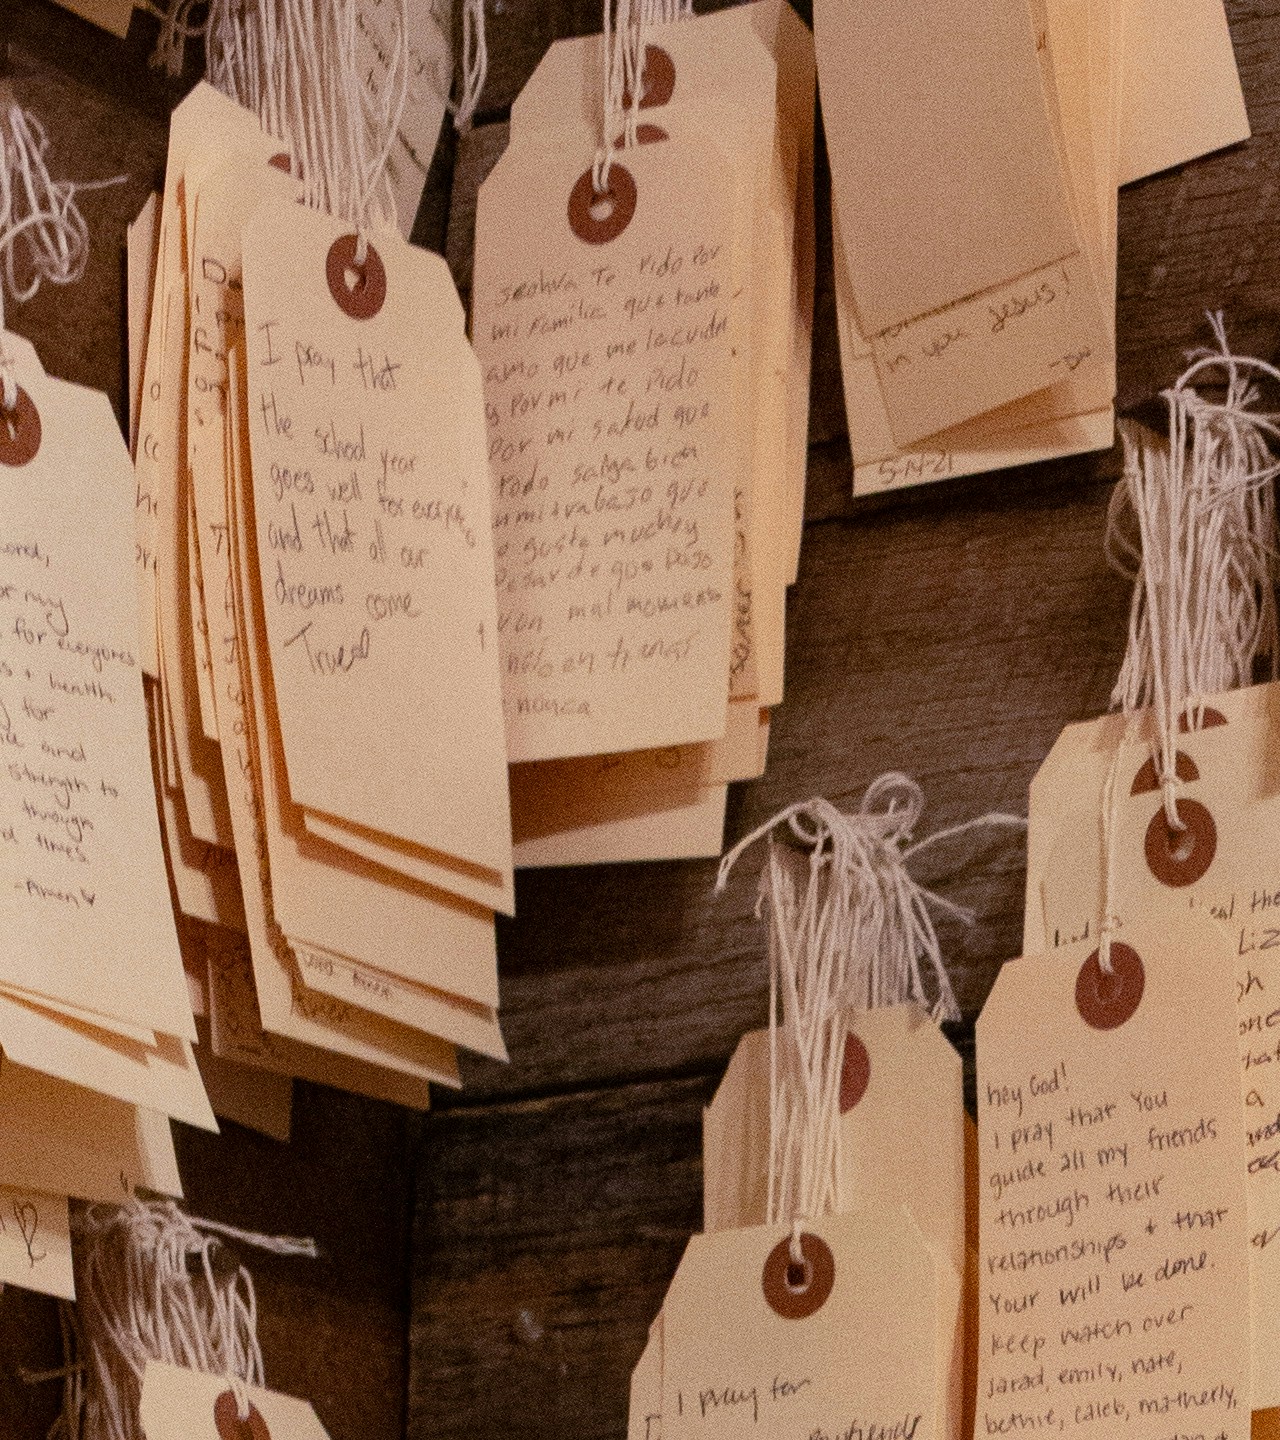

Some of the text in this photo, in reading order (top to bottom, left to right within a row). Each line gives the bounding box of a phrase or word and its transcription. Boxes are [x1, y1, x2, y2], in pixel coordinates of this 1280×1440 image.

[259, 321, 279, 366] I
[354, 350, 400, 390] that
[274, 559, 344, 610] dreams
[1010, 1121, 1054, 1153] pray
[1068, 1104, 1116, 1128] that
